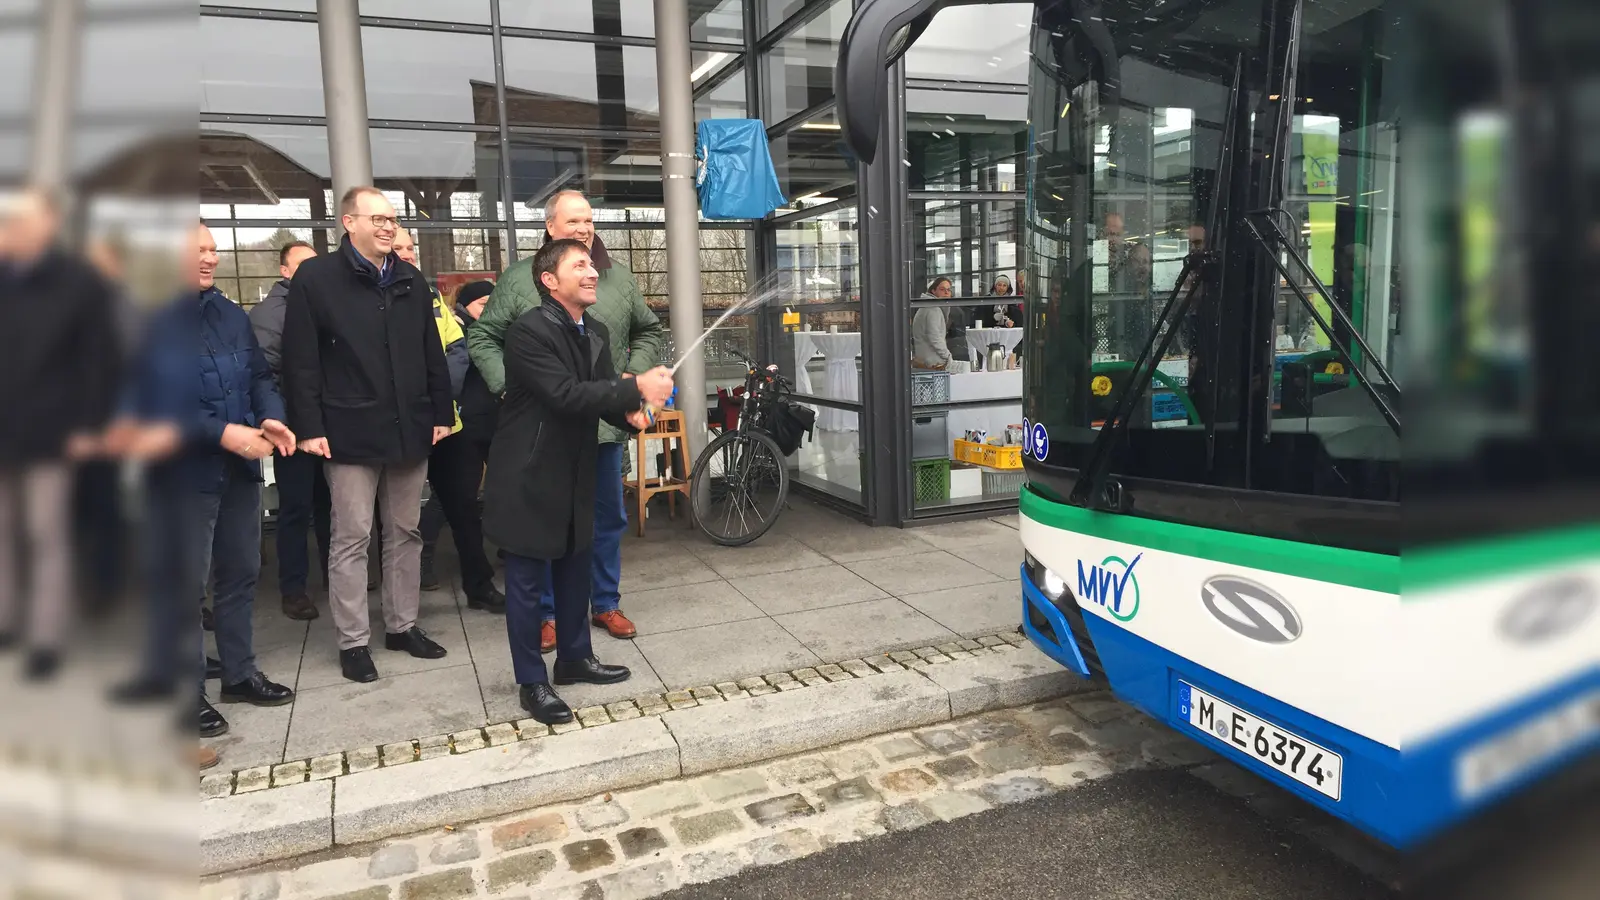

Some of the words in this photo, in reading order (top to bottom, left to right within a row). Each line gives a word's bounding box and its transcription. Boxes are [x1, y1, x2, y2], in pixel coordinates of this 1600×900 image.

[1077, 552, 1143, 612] MVV
[1181, 704, 1188, 714] D
[1199, 696, 1214, 730] M
[1231, 712, 1247, 748] E
[1254, 725, 1325, 786] 6374
